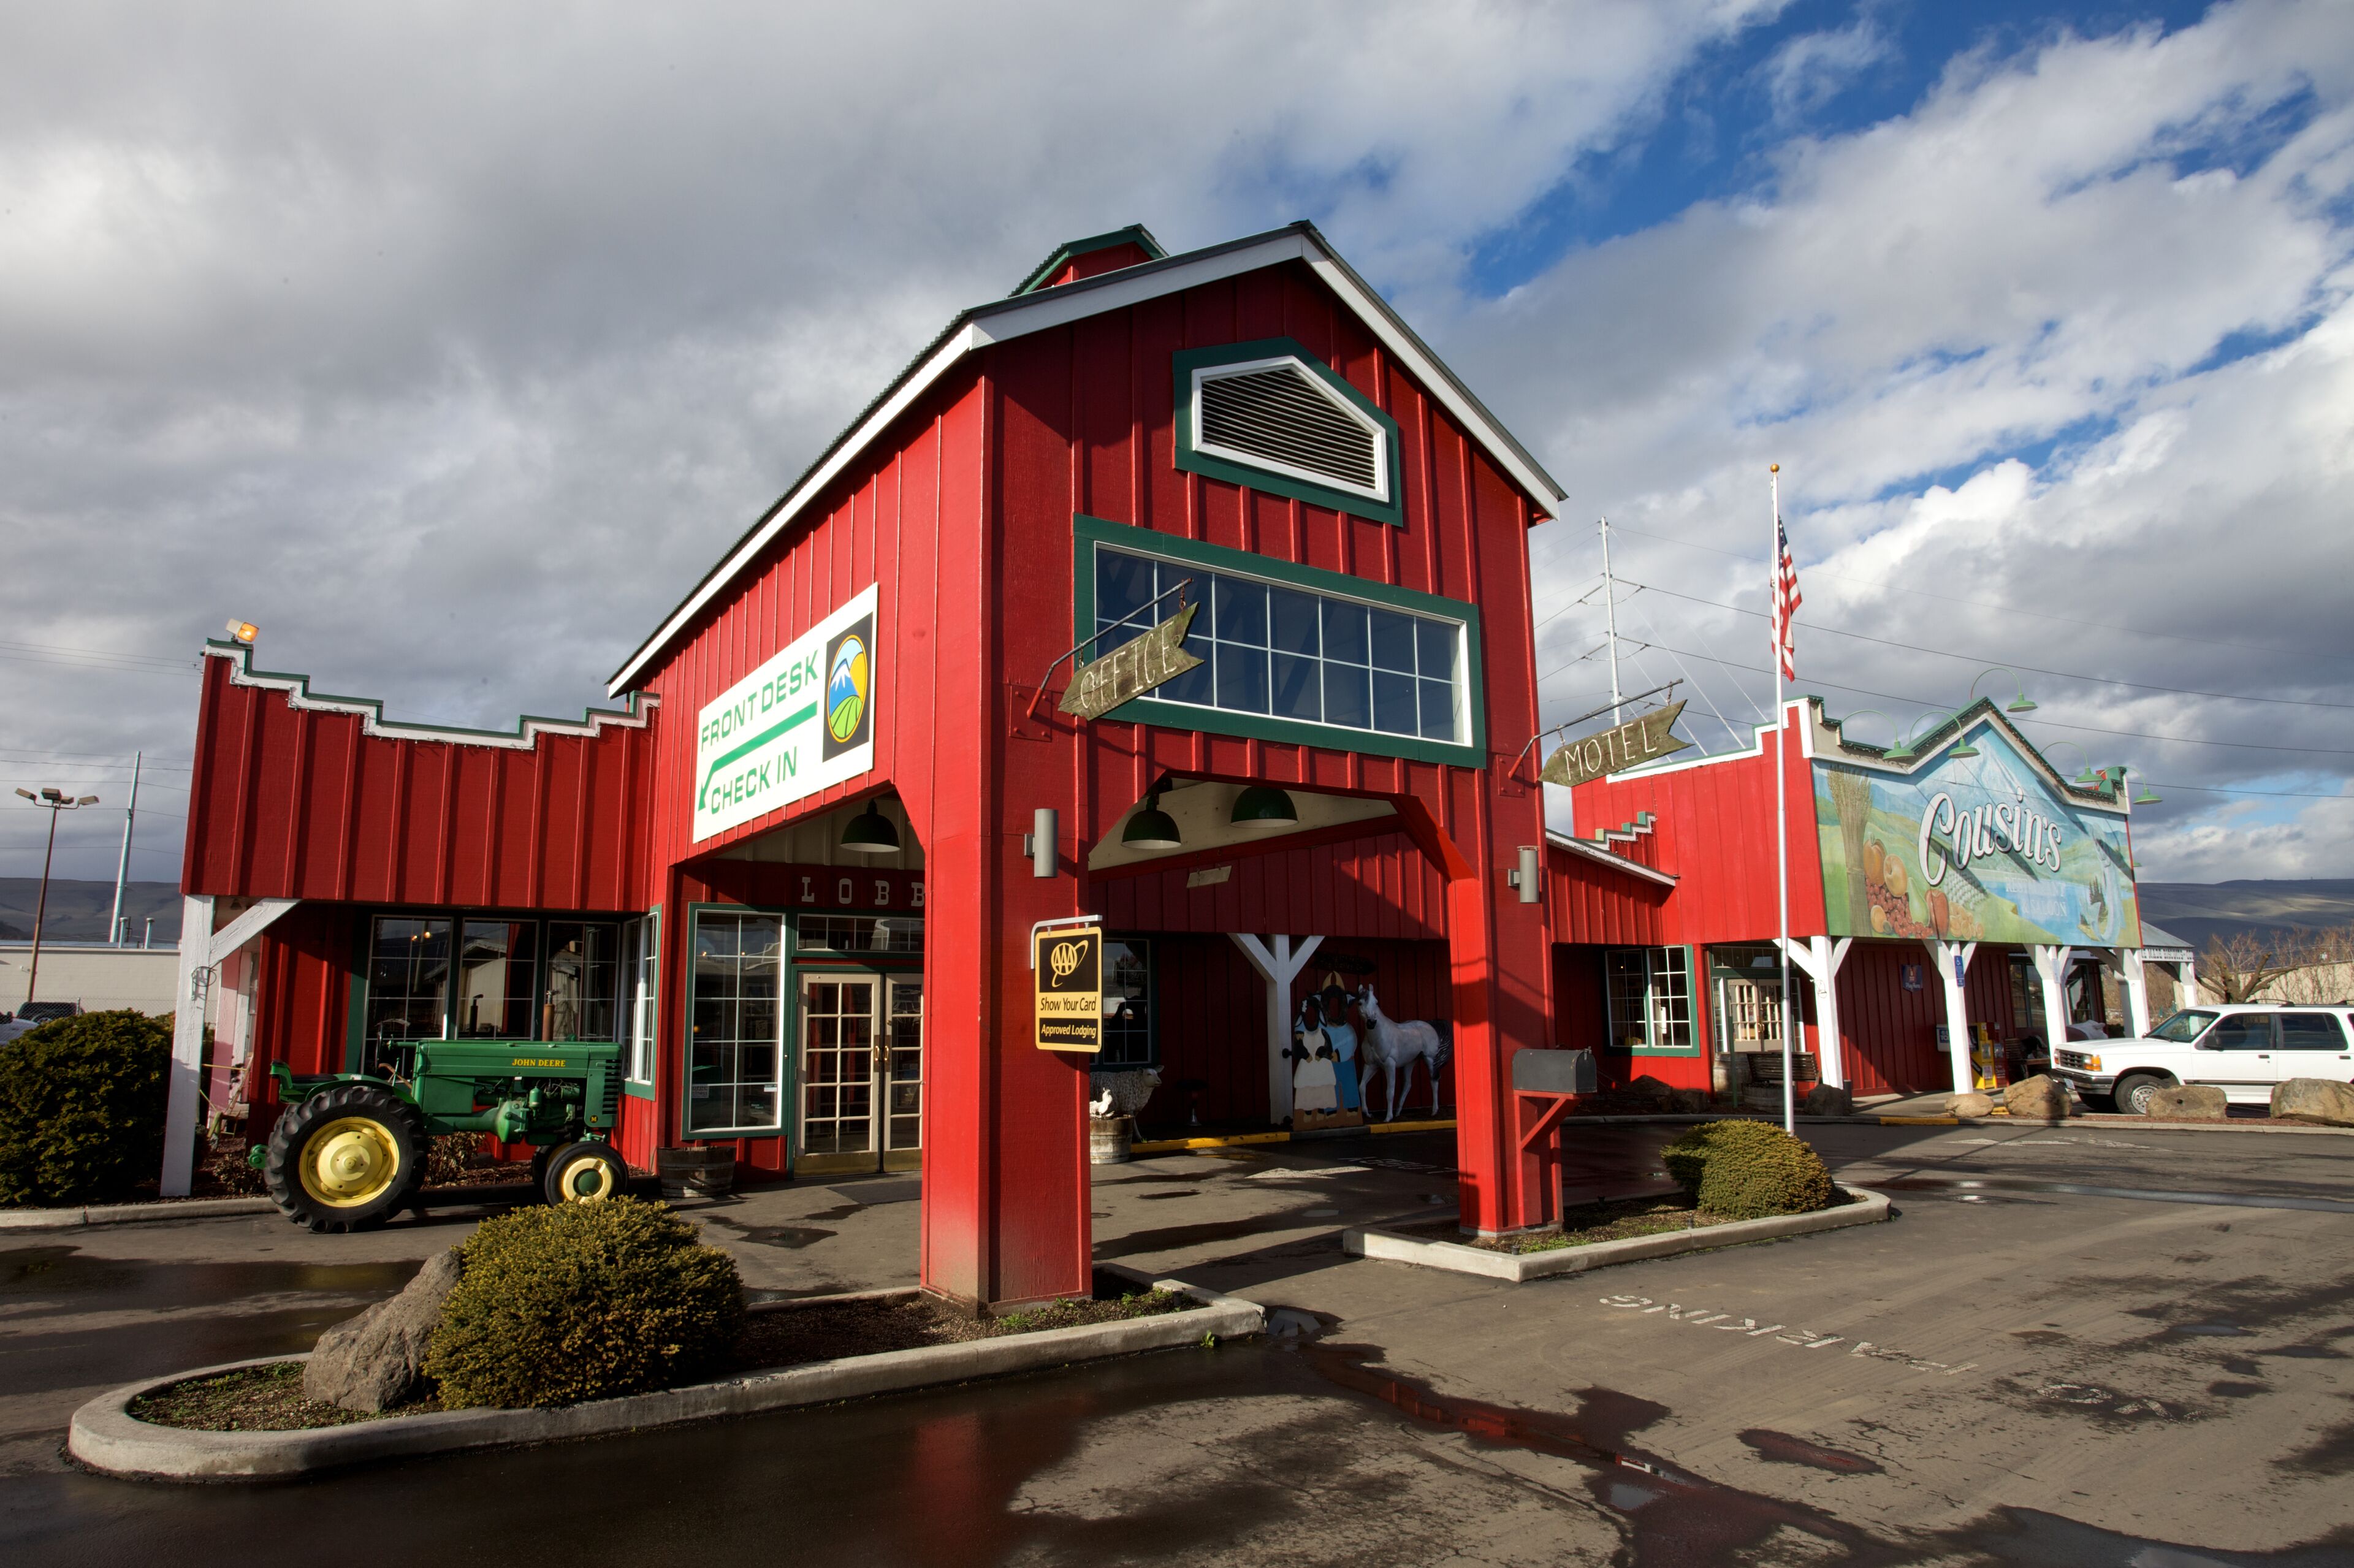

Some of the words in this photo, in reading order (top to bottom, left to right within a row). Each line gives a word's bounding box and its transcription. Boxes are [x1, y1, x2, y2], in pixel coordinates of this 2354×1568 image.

[1080, 621, 1177, 709] OFFICE
[701, 690, 757, 752] FRONT
[761, 648, 818, 714] DESK
[711, 759, 771, 815] CHECK
[777, 746, 798, 785] IN
[1564, 720, 1657, 781] MOTEL
[1918, 786, 2062, 886] Cousin's
[801, 877, 925, 907] LOBB
[1051, 943, 1077, 975] AAA
[1040, 997, 1061, 1011] Show
[1063, 997, 1079, 1011] Your
[1080, 996, 1097, 1011] Card
[1041, 1024, 1071, 1037] Approved
[1072, 1024, 1097, 1038] Lodging
[1599, 1294, 1979, 1376] PARKING
